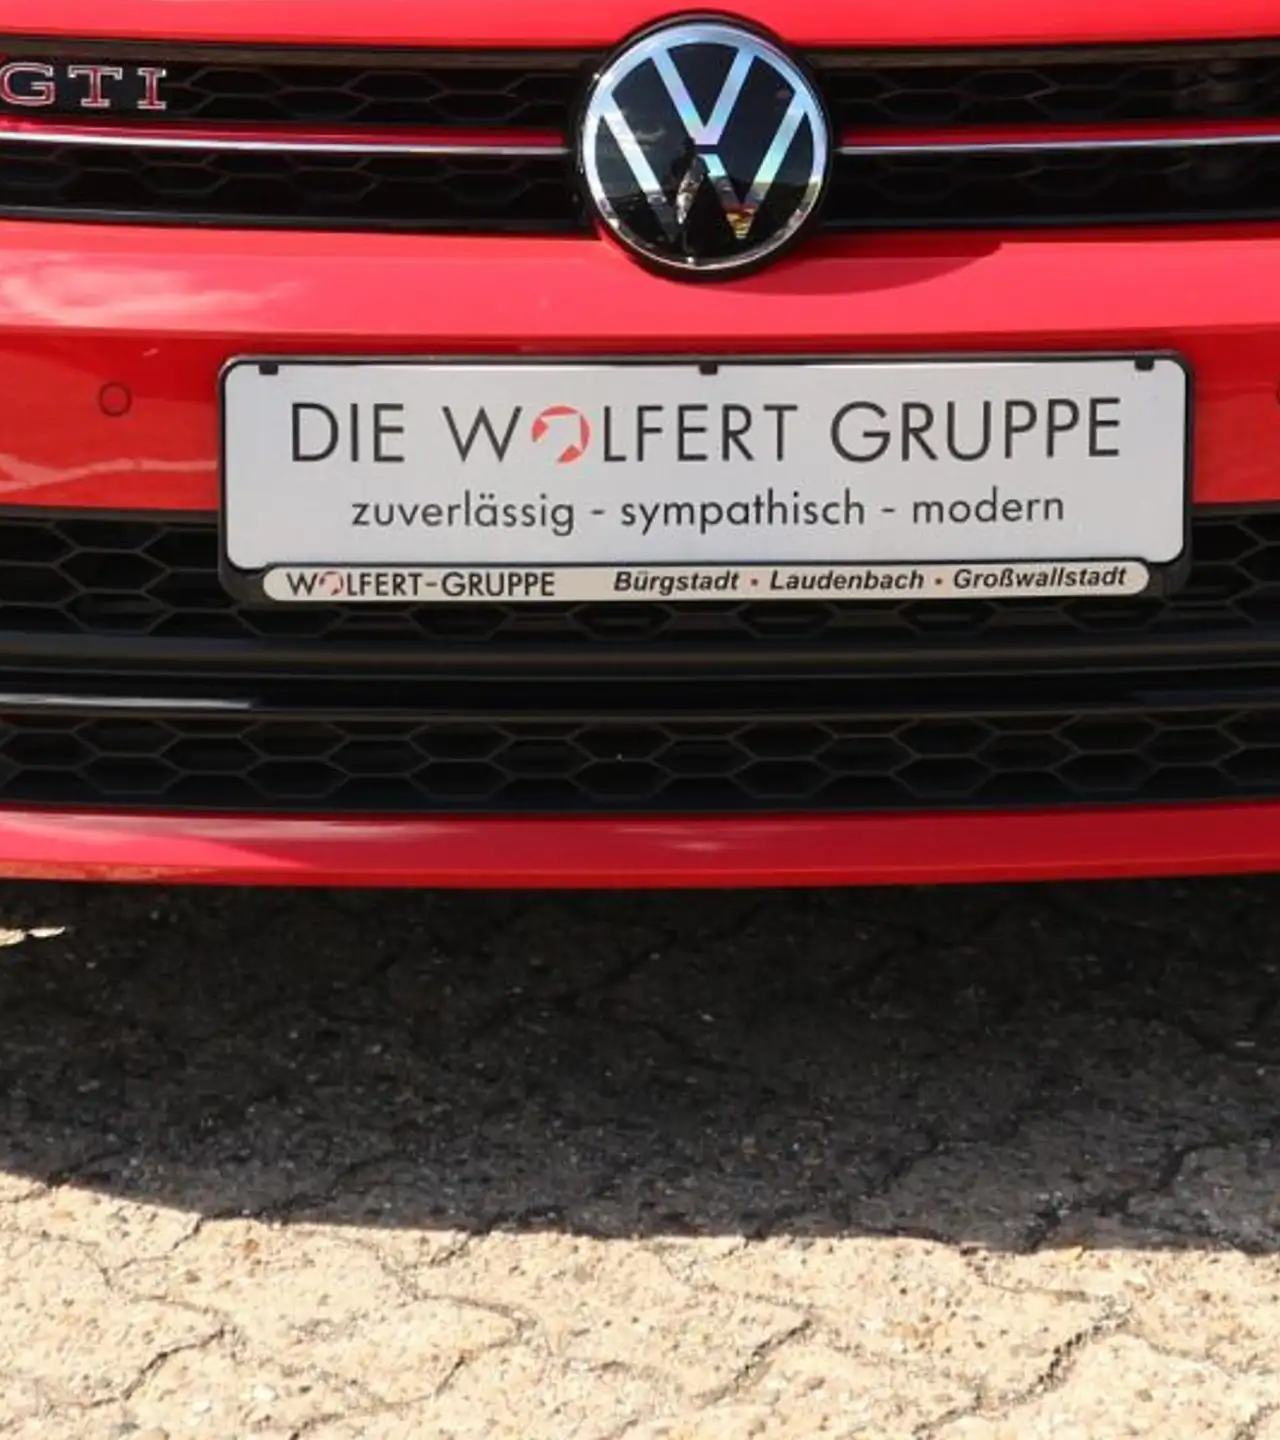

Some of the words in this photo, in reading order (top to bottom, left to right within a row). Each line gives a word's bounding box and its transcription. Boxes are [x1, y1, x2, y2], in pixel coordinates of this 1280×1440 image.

[588, 29, 822, 260] VW
[291, 402, 406, 463] DIE
[441, 402, 799, 465] WOLFERT
[829, 396, 1122, 463] GRUPPE
[350, 489, 576, 537] zuverlässig
[619, 486, 866, 536] sympathisch
[912, 485, 1065, 525] modern
[612, 569, 740, 597] Bürgstadt
[769, 567, 925, 592] Laudenbach
[952, 565, 1128, 591] Großwallstadt
